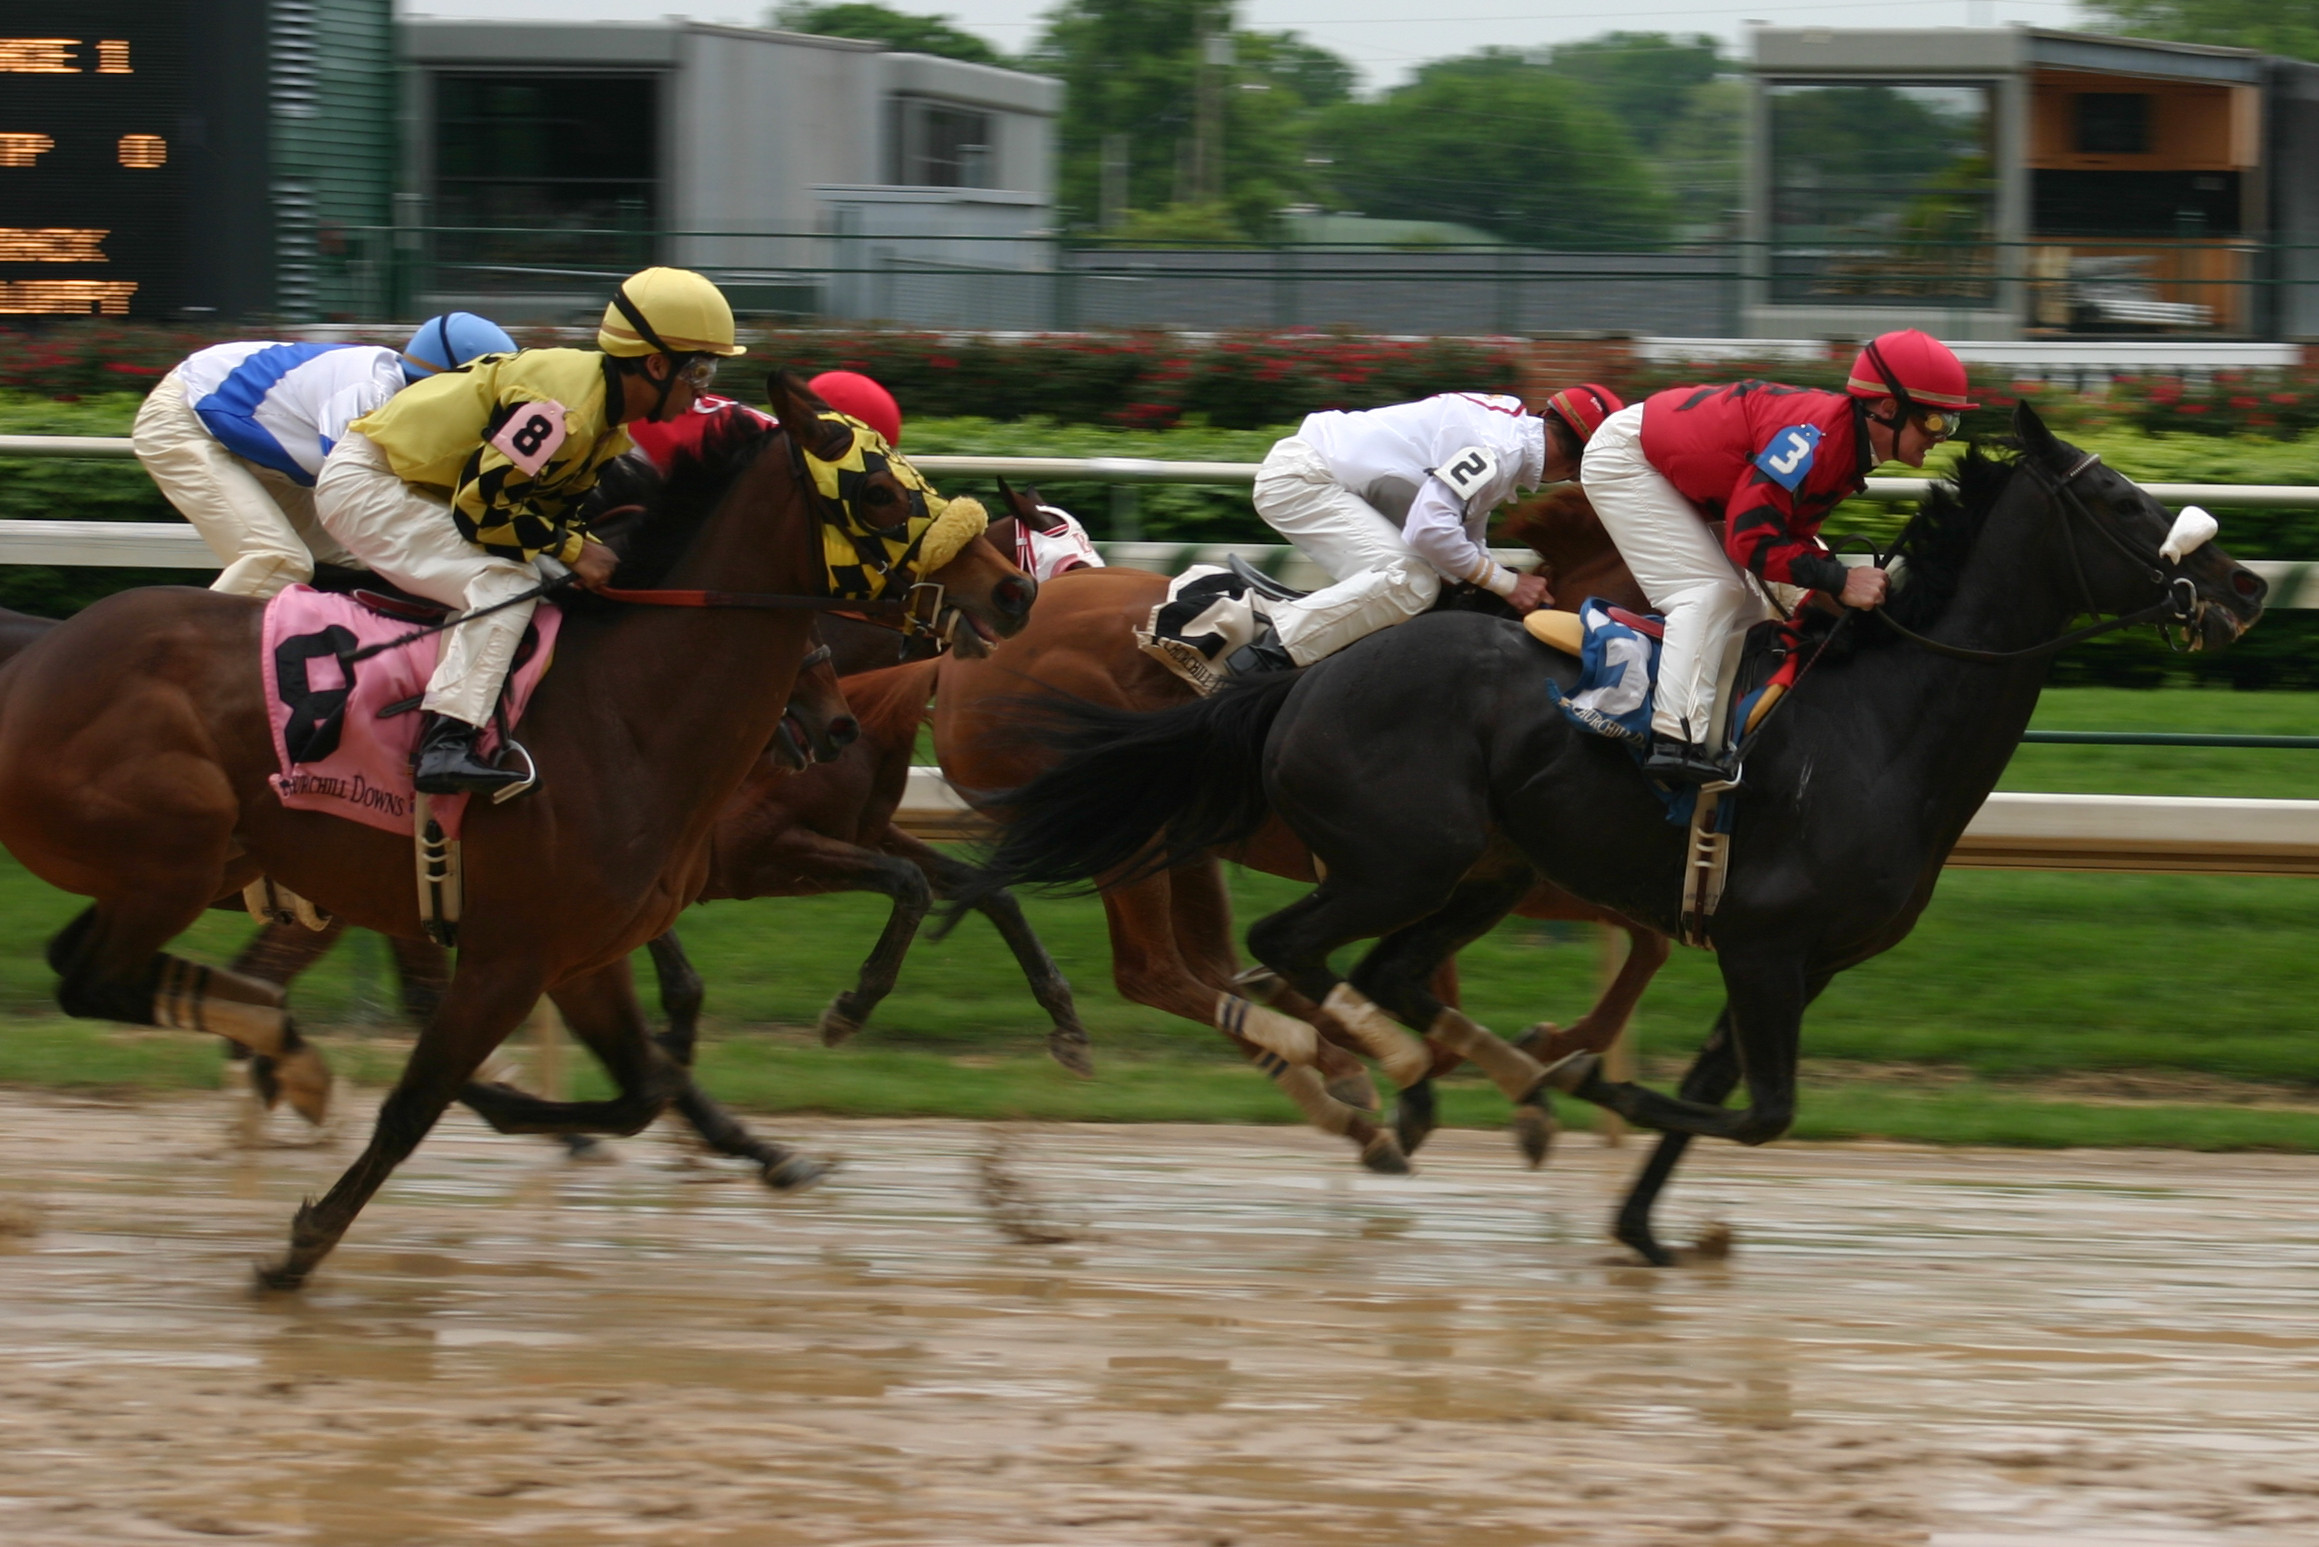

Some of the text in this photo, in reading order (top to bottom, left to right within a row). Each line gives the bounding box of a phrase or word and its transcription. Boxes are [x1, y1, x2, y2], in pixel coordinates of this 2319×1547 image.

[512, 414, 553, 457] 8
[1769, 432, 1810, 475] 3
[1450, 451, 1487, 486] 2
[275, 624, 359, 763] 8
[350, 774, 404, 816] DOWNS
